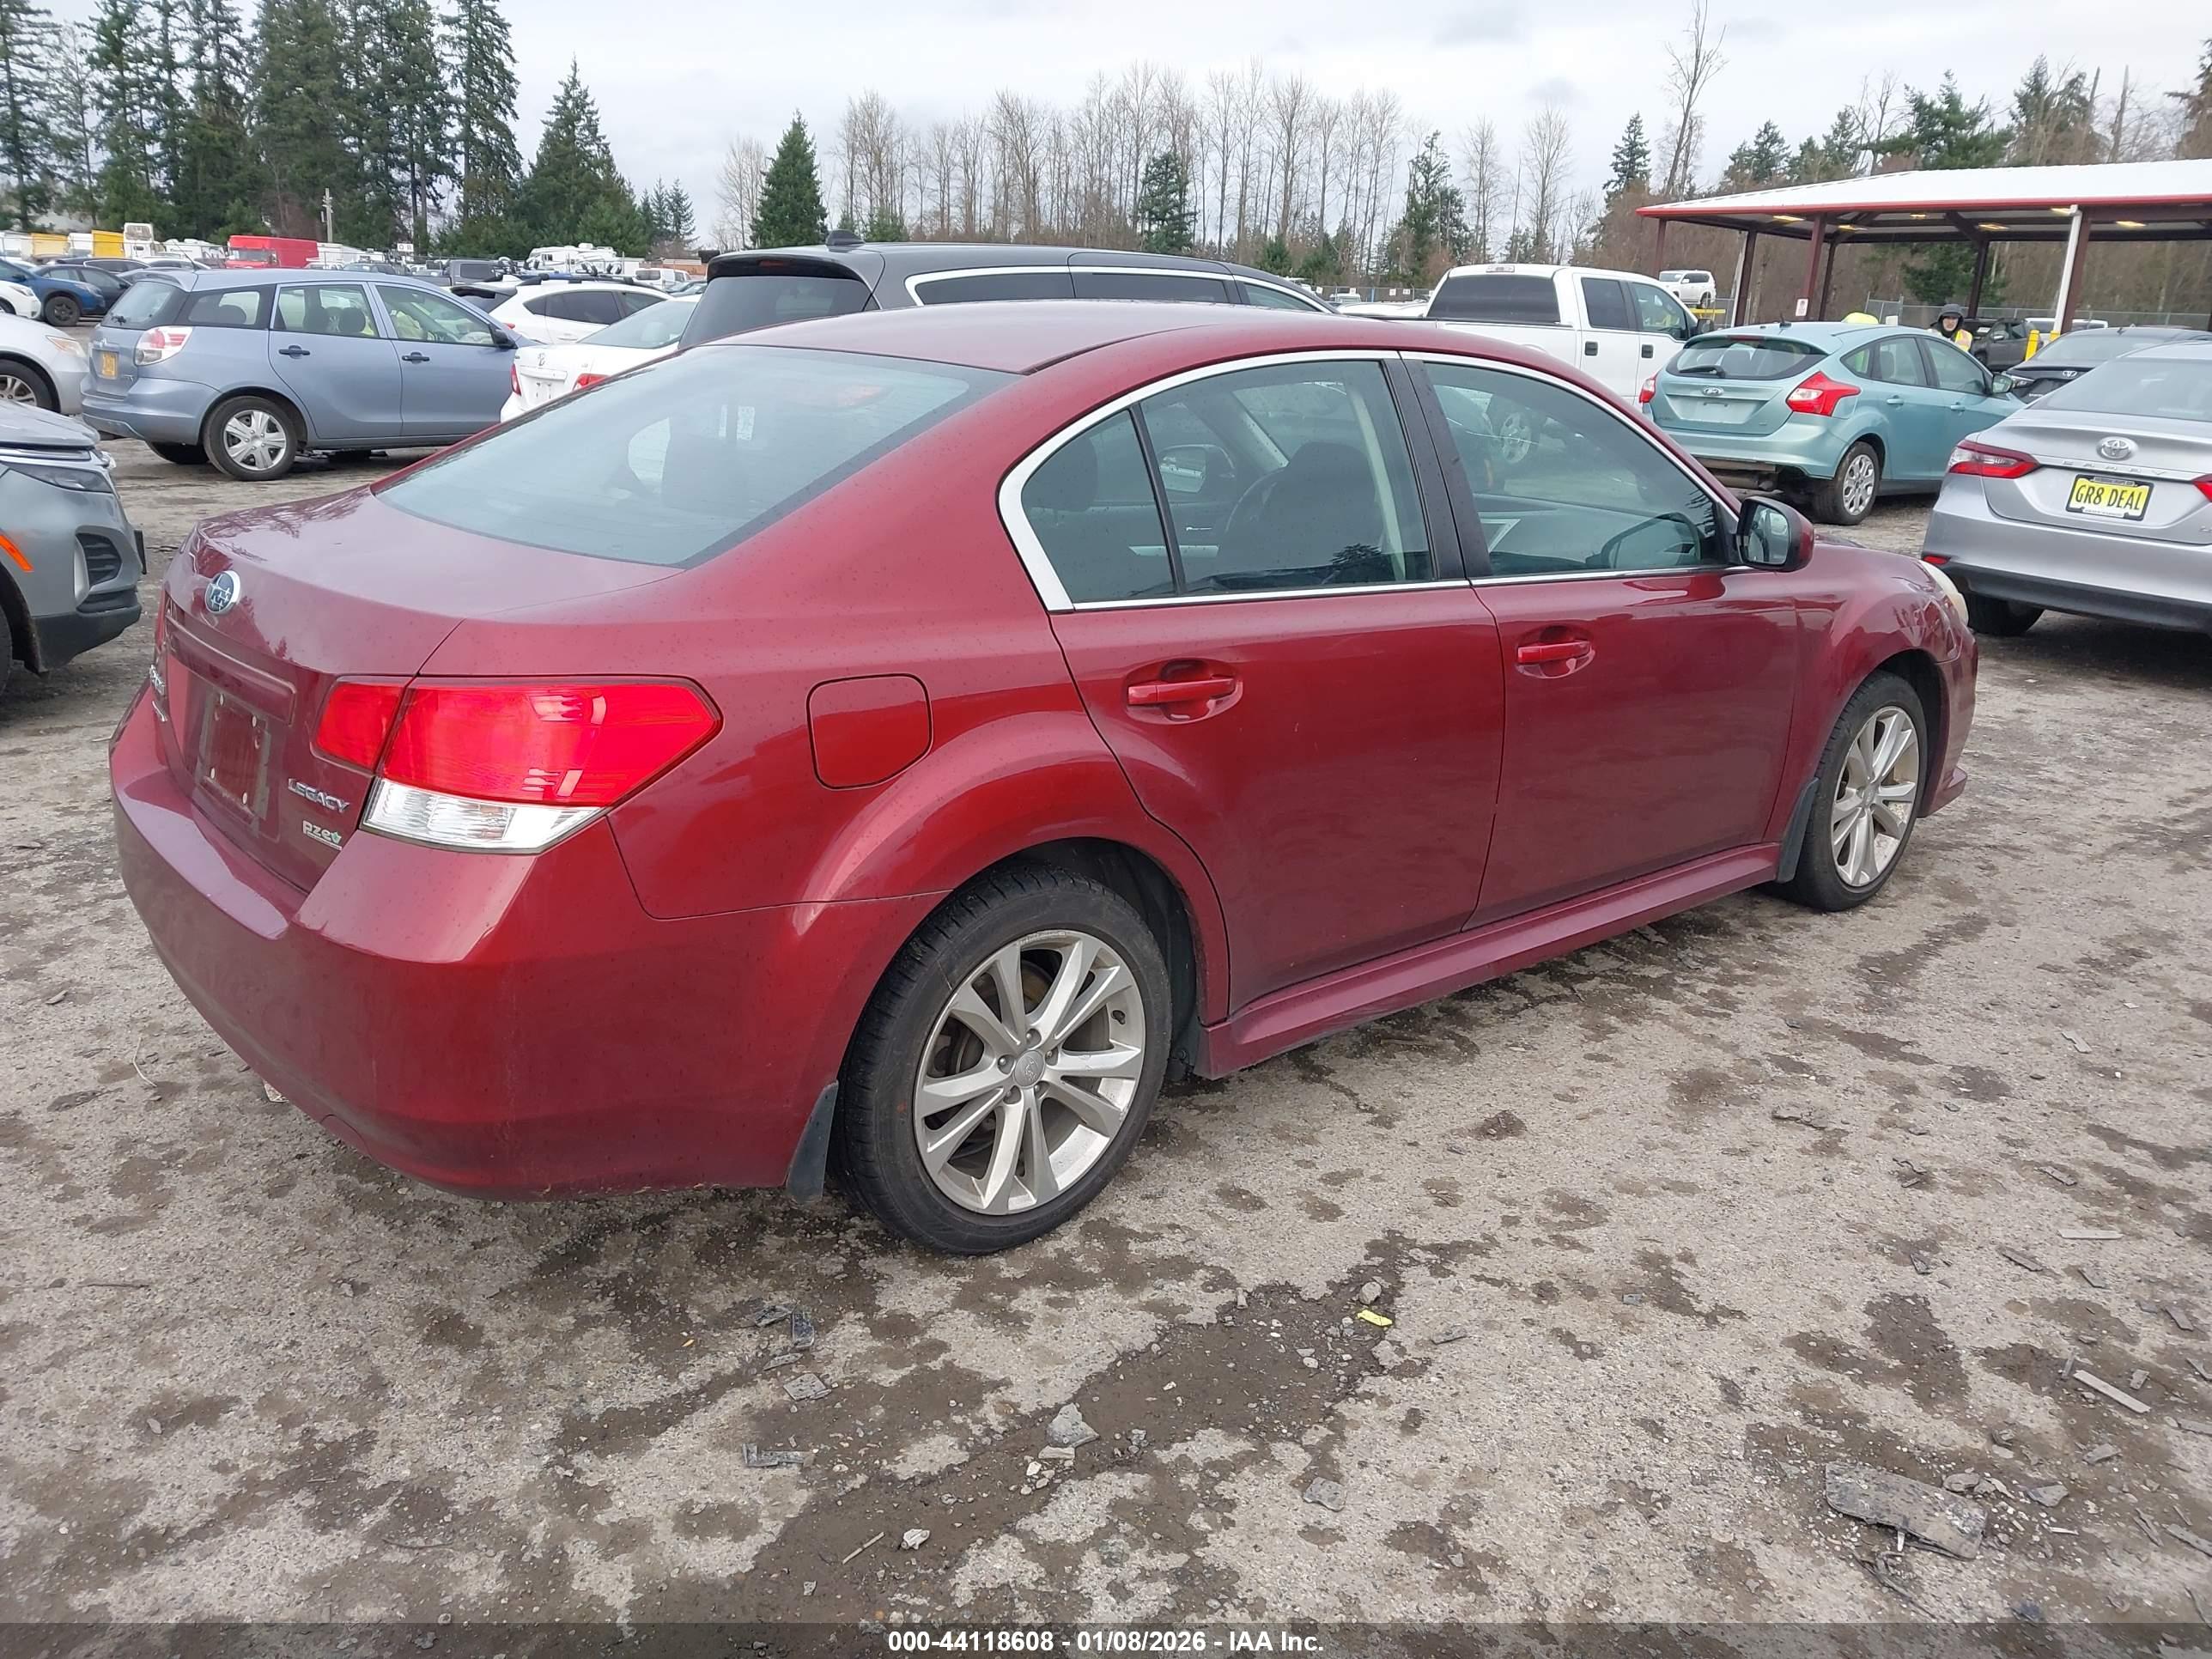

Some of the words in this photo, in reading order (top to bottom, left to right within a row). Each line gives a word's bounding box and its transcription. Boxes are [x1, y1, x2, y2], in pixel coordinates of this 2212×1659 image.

[2075, 484, 2105, 506] GR8
[2106, 488, 2143, 511] DEAL
[288, 778, 350, 814] LEGACY
